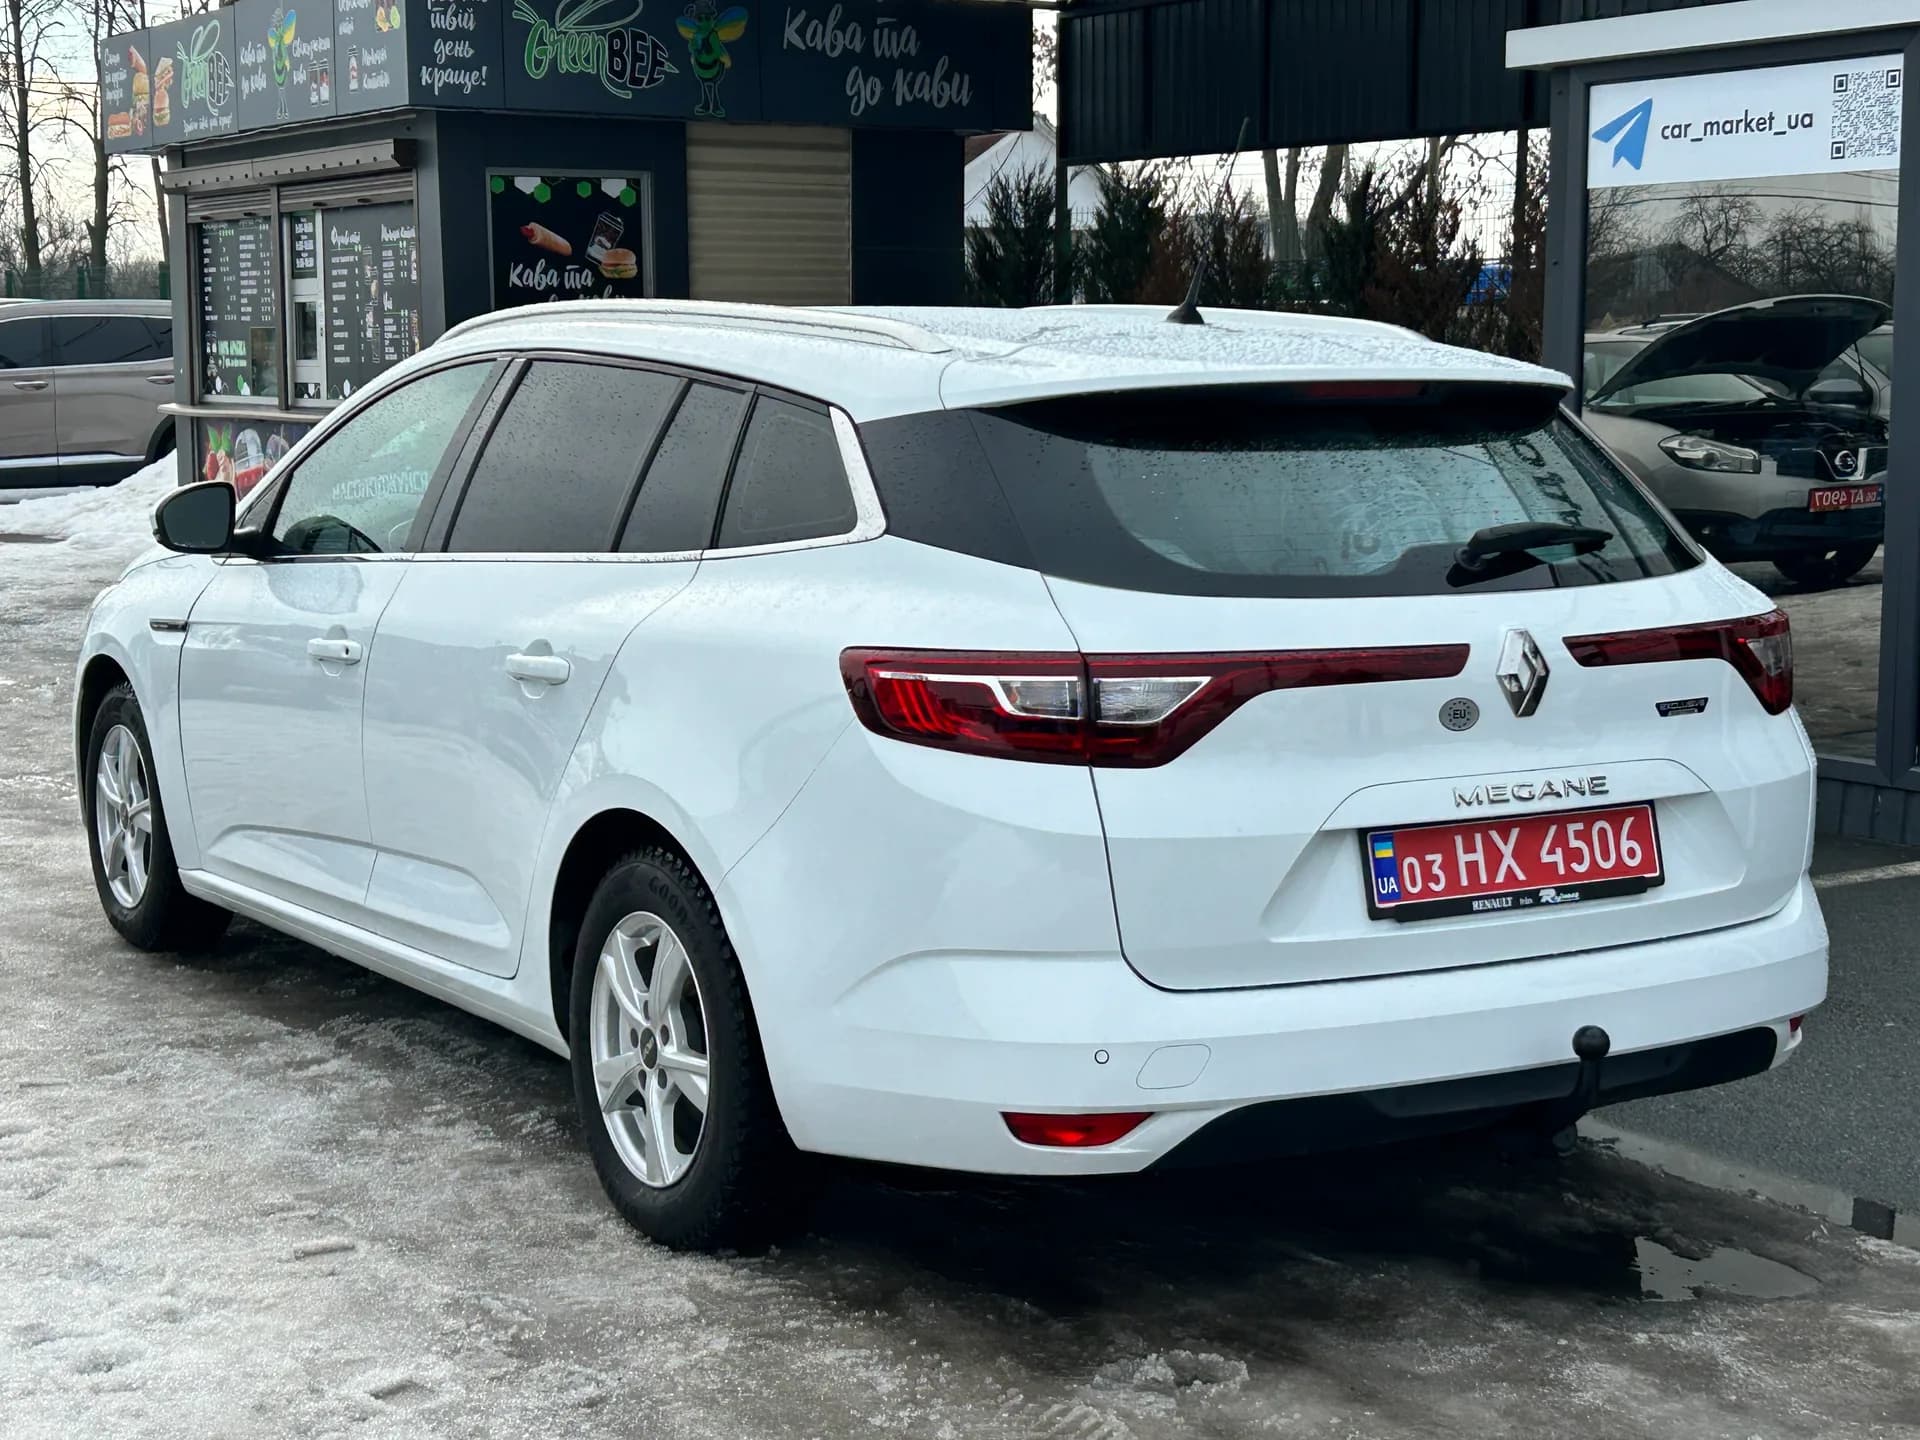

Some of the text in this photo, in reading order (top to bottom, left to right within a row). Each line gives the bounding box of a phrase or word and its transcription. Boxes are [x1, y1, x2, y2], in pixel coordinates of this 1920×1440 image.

[430, 2, 476, 31] твій
[783, 3, 920, 58] Кава та
[434, 38, 475, 64] день
[420, 65, 488, 95] краще!
[846, 55, 973, 116] до кави
[1661, 109, 1813, 142] car_market_ua
[509, 258, 595, 291] Кава та
[1453, 708, 1467, 719] EU
[1453, 776, 1609, 808] MEGANE
[1402, 816, 1643, 894] 03 HX 4506
[1378, 876, 1399, 894] UA
[1472, 896, 1514, 912] RENAULT
